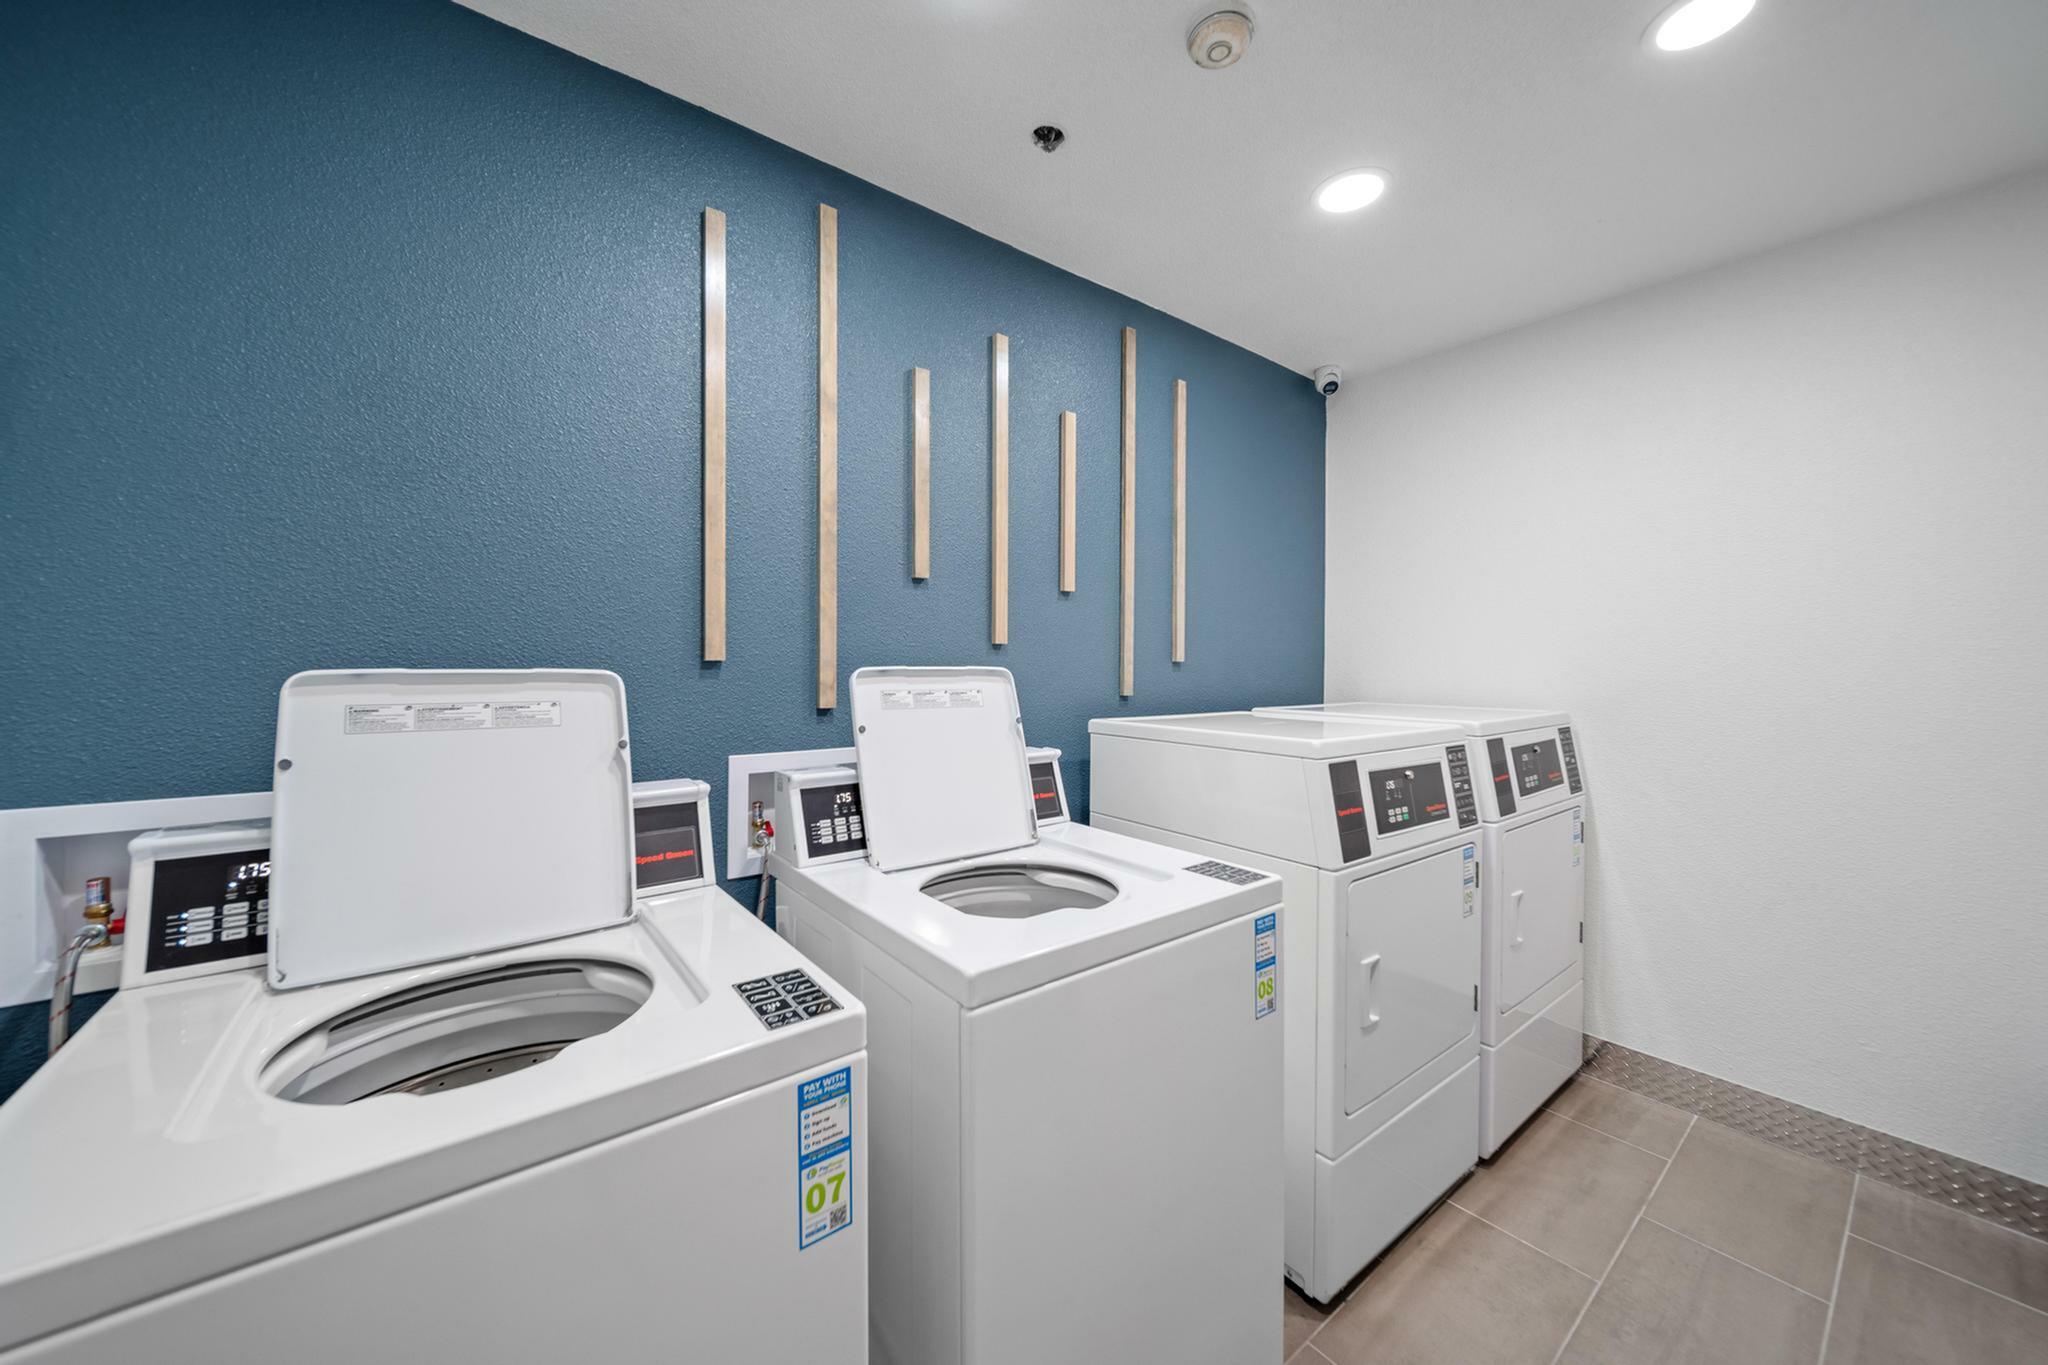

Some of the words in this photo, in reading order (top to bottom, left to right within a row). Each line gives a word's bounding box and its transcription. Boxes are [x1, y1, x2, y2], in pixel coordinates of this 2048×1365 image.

[1258, 977, 1274, 1000] 08
[803, 1080, 821, 1095] PAY
[822, 1071, 846, 1088] WITH
[805, 1170, 846, 1214] 07
